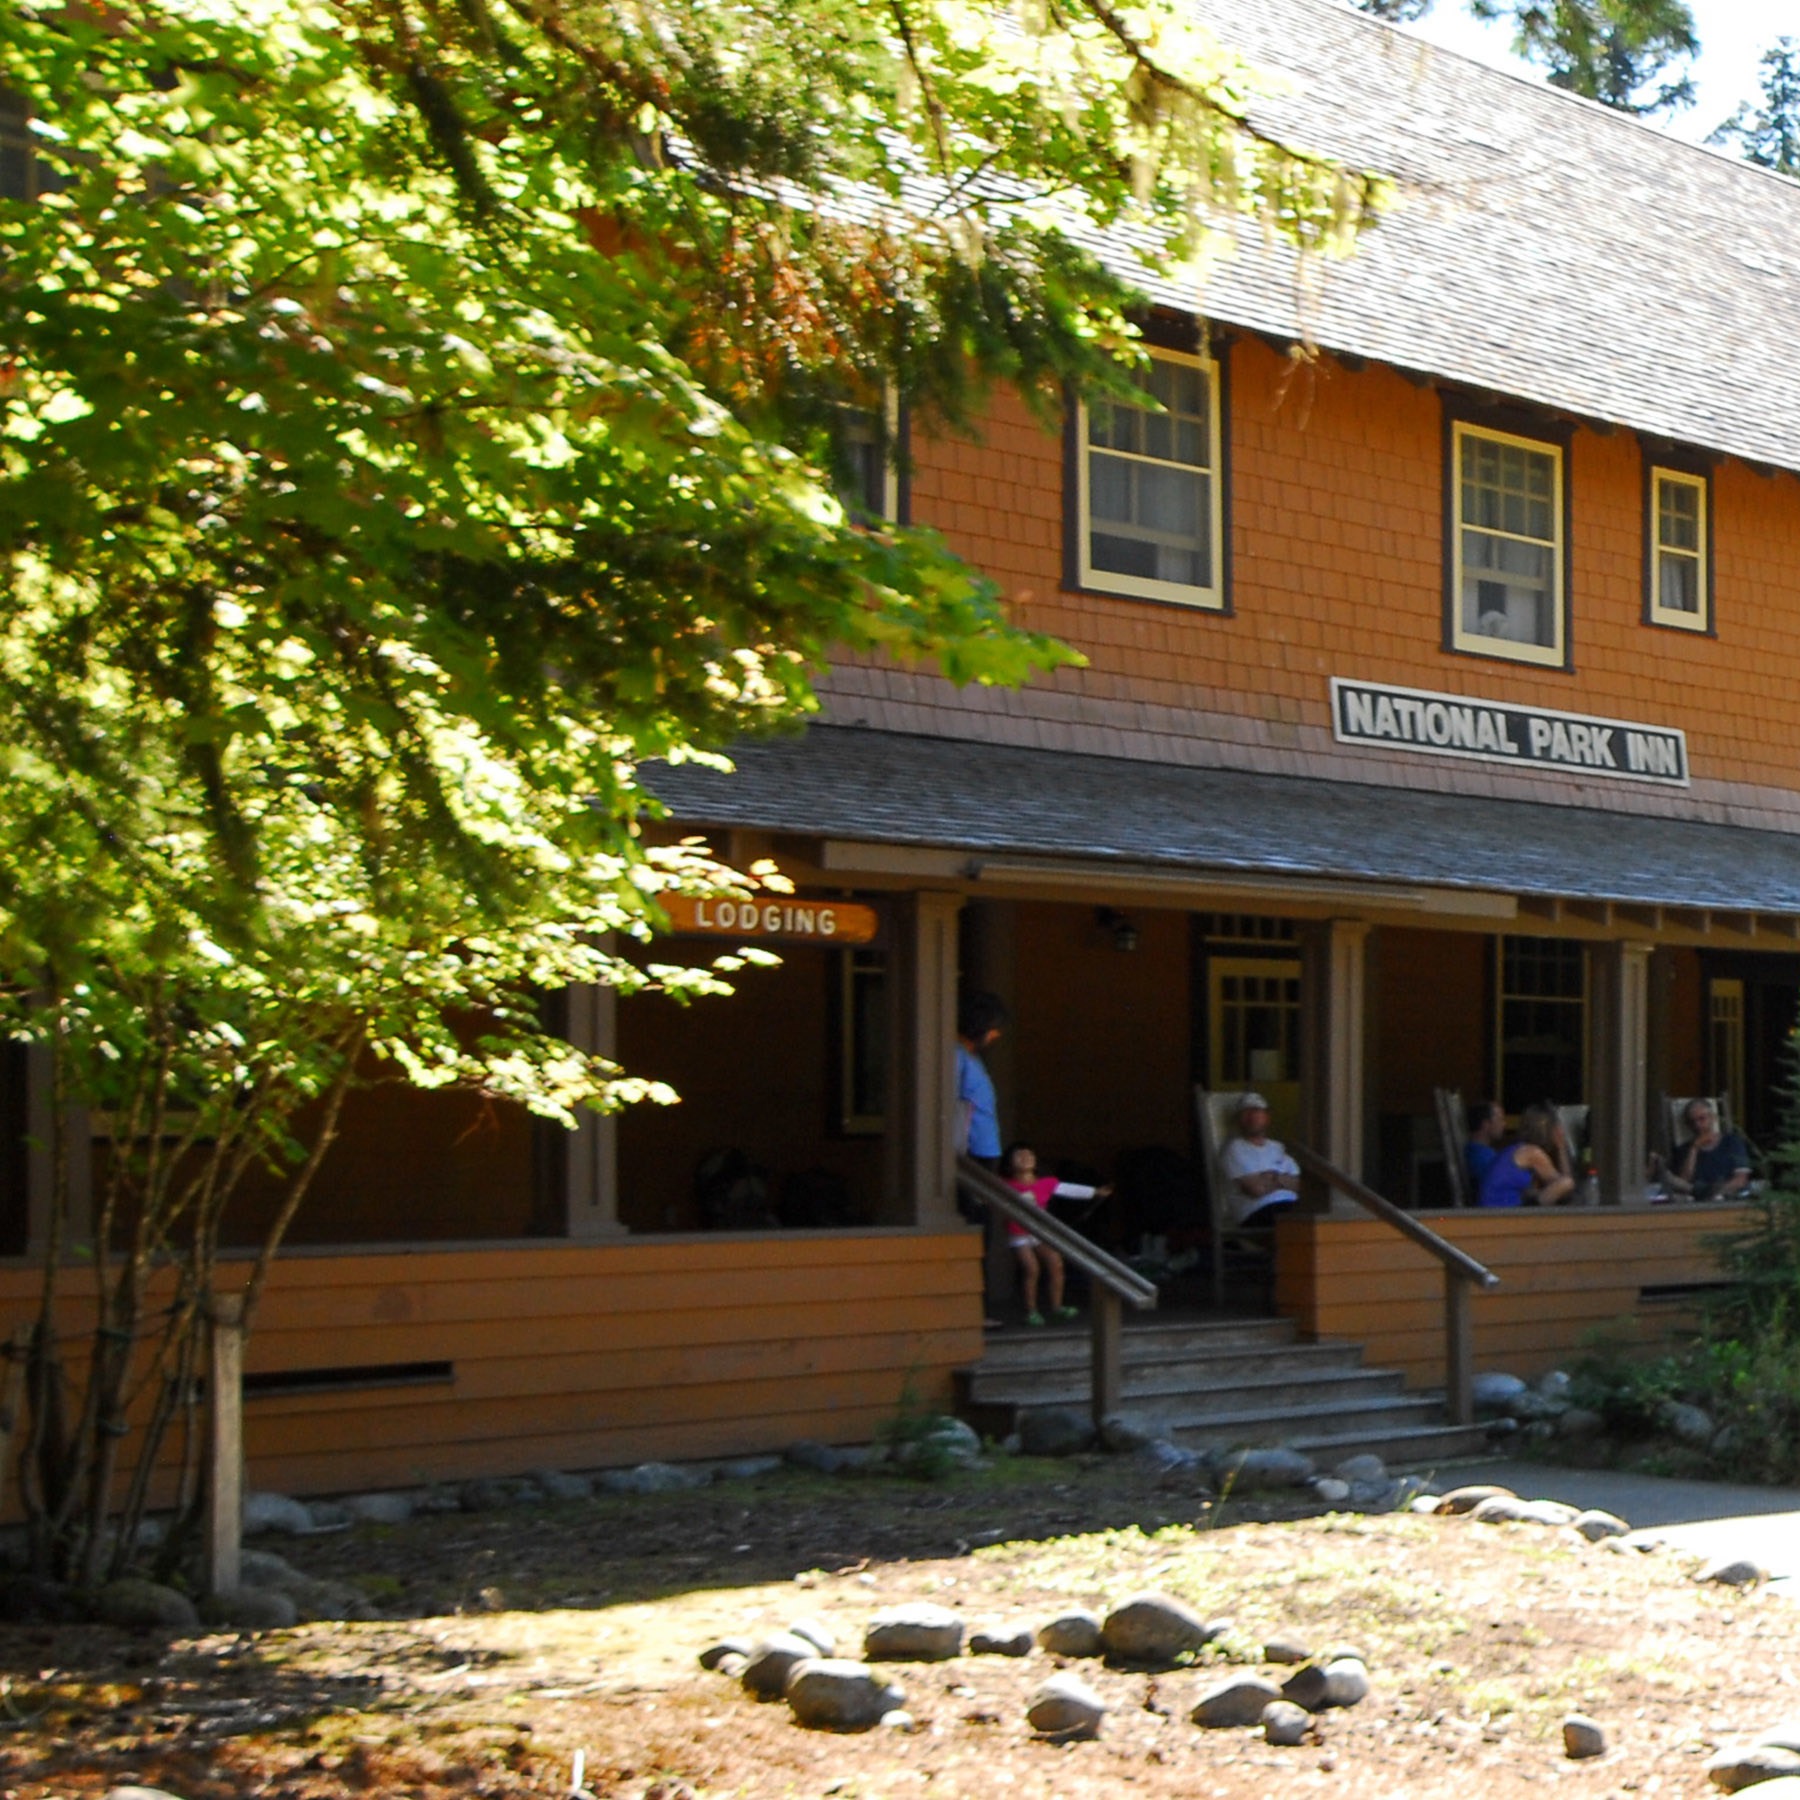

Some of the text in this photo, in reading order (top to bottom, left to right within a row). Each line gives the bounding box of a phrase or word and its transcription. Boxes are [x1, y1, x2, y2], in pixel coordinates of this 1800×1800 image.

[1344, 691, 1678, 776] NATIONAL PARK INN
[695, 901, 837, 935] LODGING
